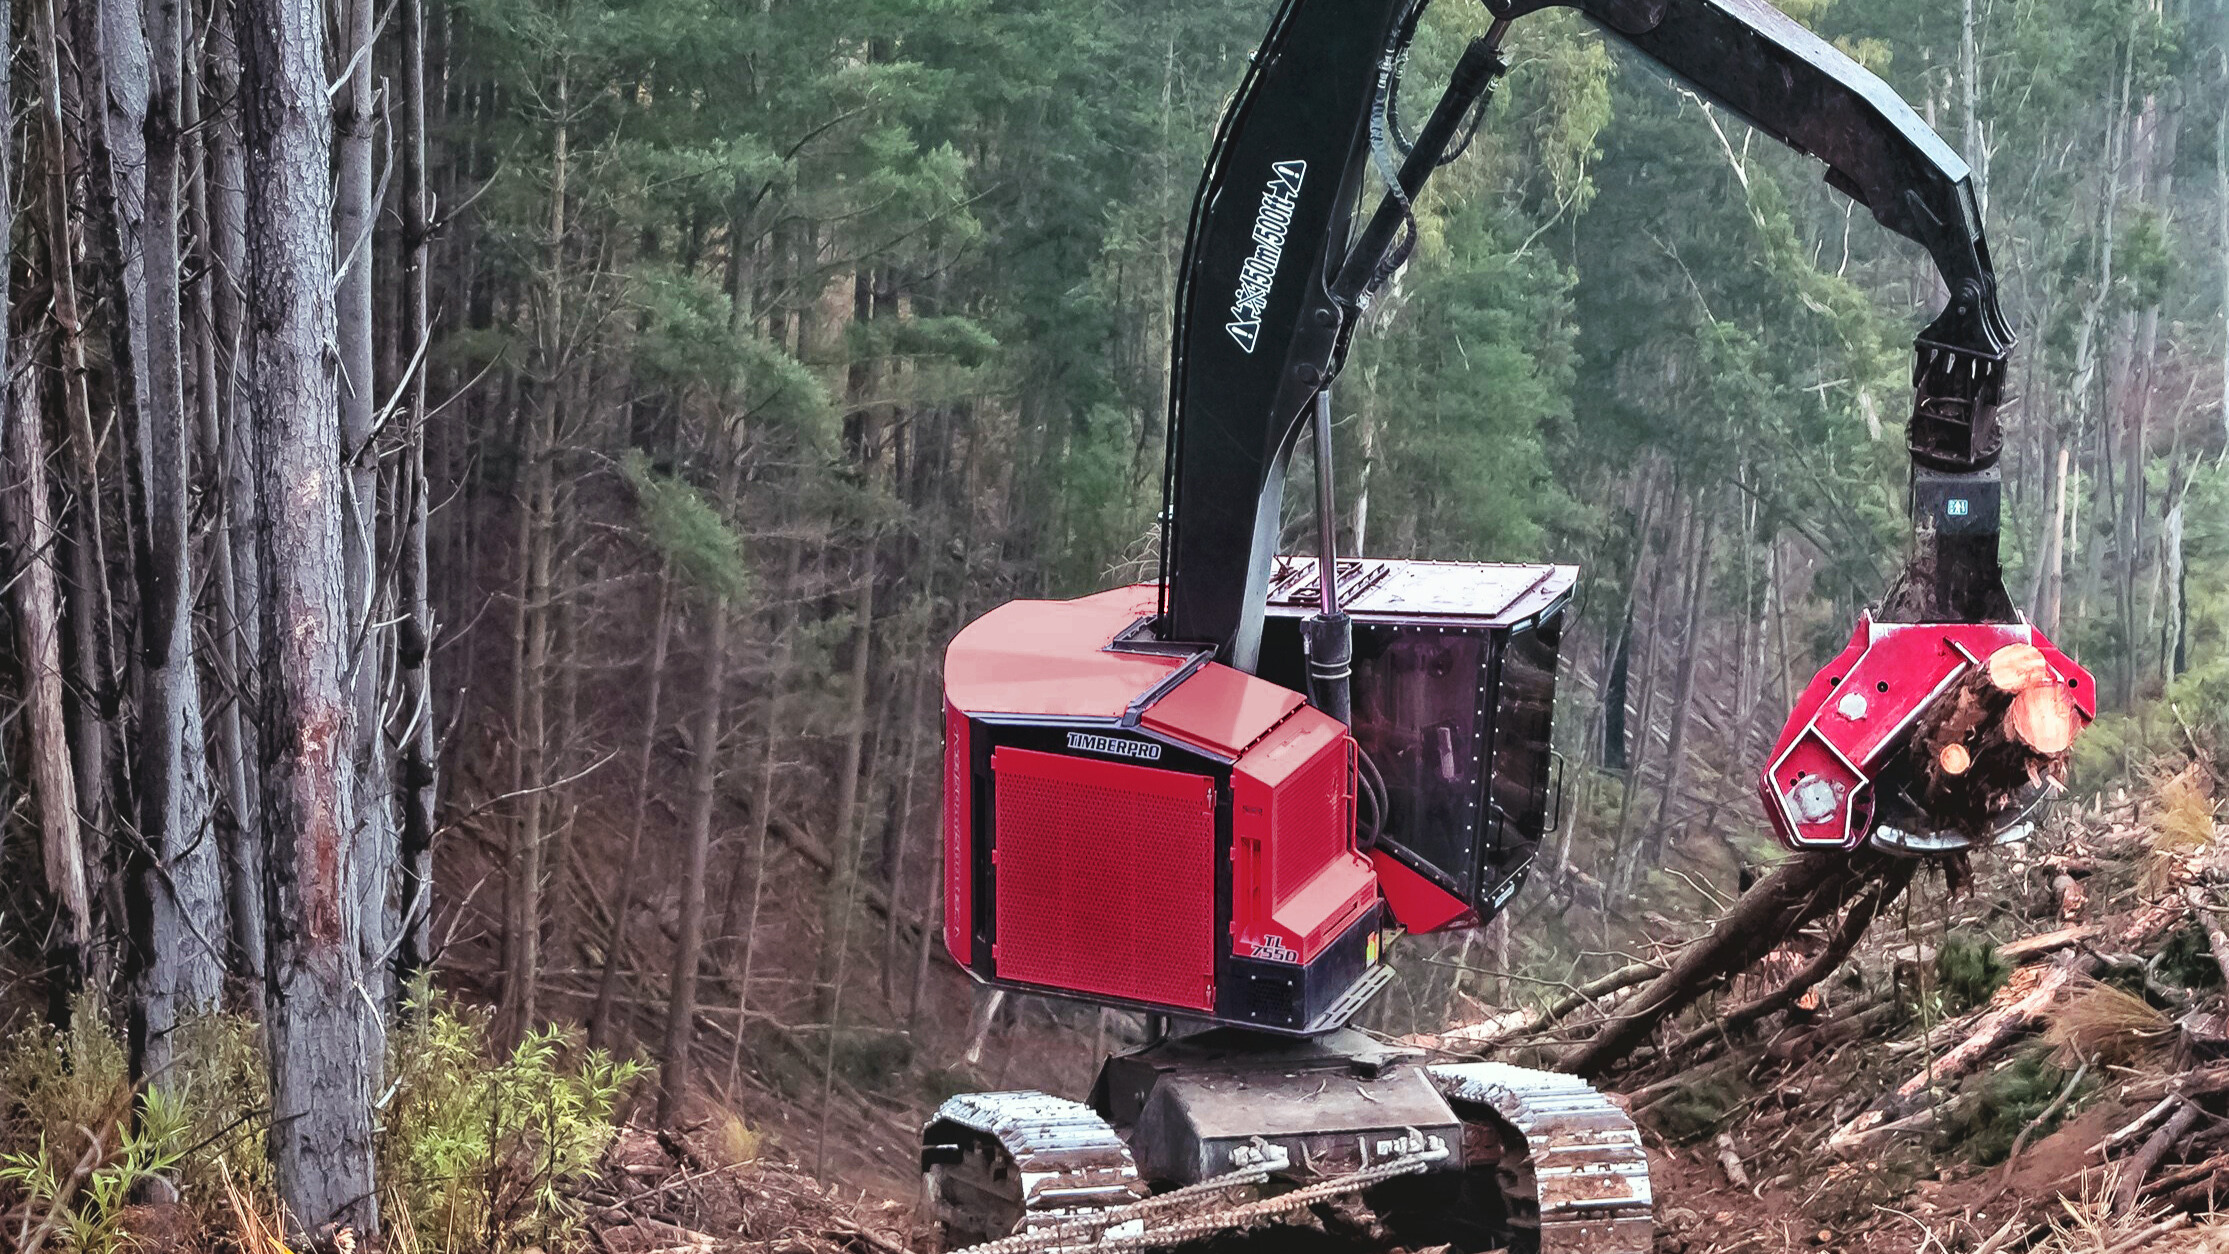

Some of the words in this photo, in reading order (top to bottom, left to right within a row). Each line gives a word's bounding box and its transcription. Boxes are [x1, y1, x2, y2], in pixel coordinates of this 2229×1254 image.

[1239, 195, 1295, 293] 150m/500ft
[1067, 732, 1161, 759] TIMBERPRO
[1264, 934, 1286, 949] TL
